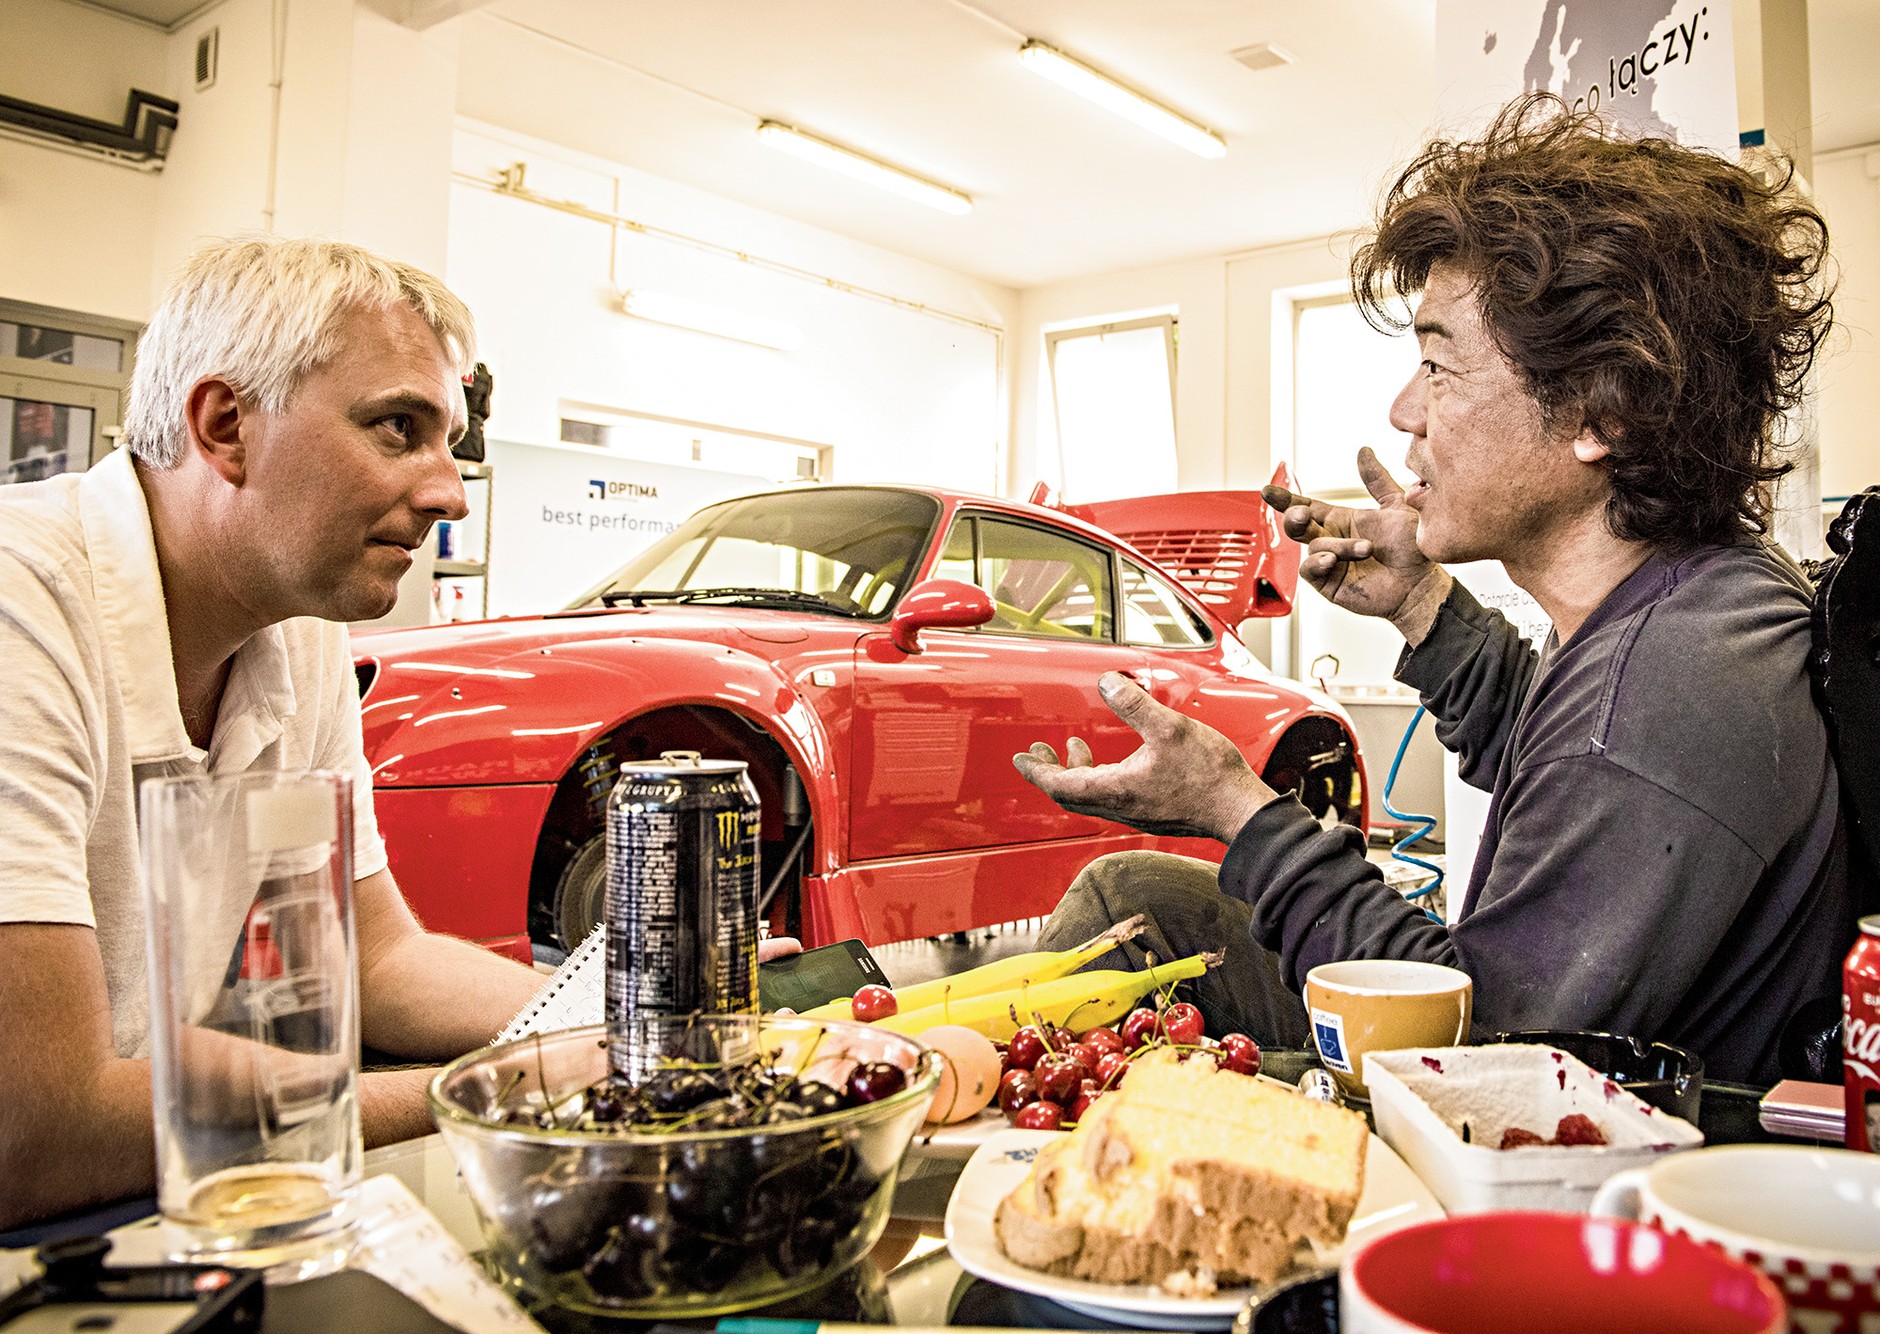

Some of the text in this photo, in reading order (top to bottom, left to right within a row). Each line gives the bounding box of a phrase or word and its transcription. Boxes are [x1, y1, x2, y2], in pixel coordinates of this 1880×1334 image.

[1609, 7, 1709, 98] łączy:
[608, 481, 658, 499] OPTIMA
[541, 505, 583, 526] best
